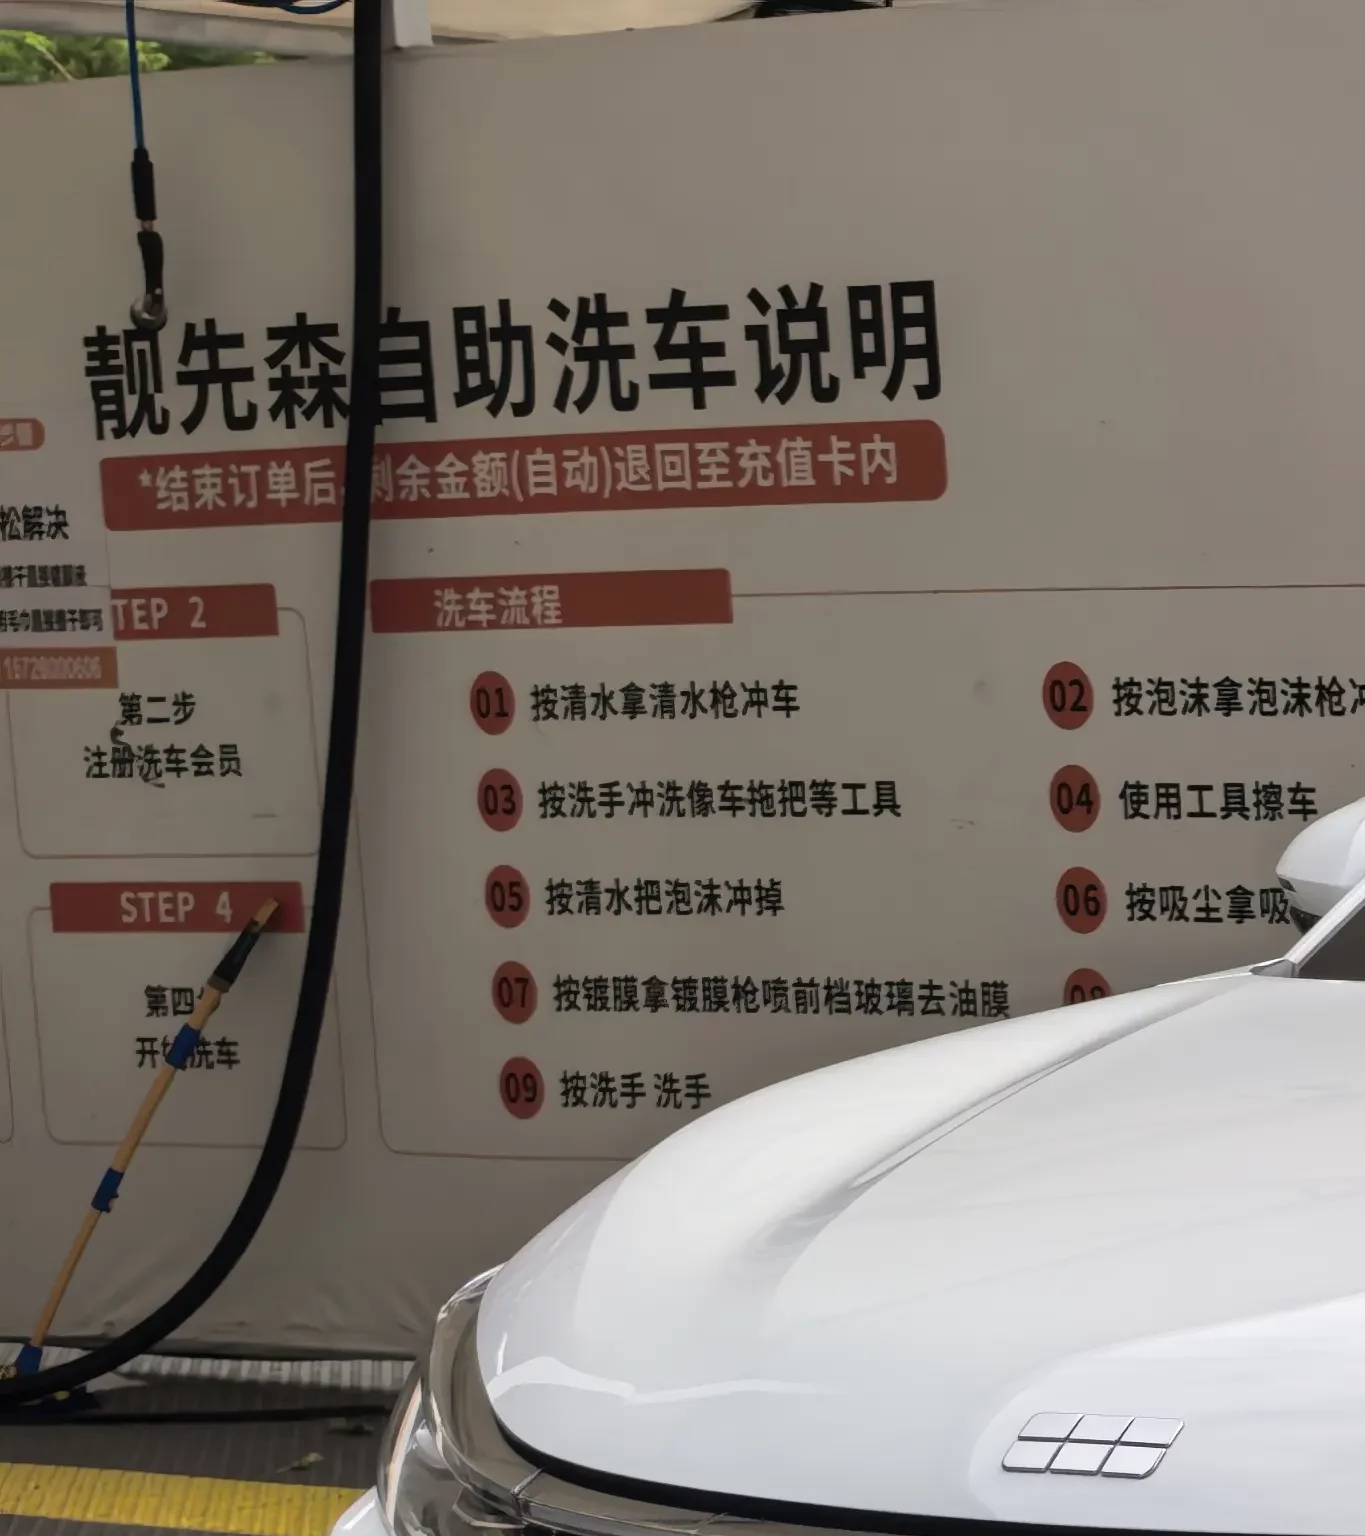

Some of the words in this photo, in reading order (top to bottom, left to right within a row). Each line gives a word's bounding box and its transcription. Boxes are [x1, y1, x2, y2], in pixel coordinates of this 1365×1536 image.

[83, 280, 942, 441] 靓先森自助洗车说明
[111, 596, 169, 631] TEP
[188, 595, 207, 628] 2
[434, 585, 562, 627] 洗车流程
[118, 691, 196, 726] 第二步
[476, 687, 509, 719] 01
[530, 679, 801, 722] 按清水拿清水枪冲车
[1049, 678, 1088, 713] 02
[83, 743, 243, 780] 注册洗车会员
[483, 784, 516, 816] 03
[537, 778, 902, 819] 按洗手冲洗像车拖把等工具
[1056, 782, 1094, 815] 04
[1118, 780, 1318, 822] 使用工具擦车
[120, 891, 195, 923] STEP
[215, 891, 233, 924] 4
[490, 880, 523, 913] 05
[544, 877, 785, 917] 按清水把泡沫冲掉
[1063, 883, 1101, 917] 06
[1124, 880, 1290, 925] 按吸尘拿吸
[497, 976, 530, 1008] 07
[504, 1072, 537, 1104] 09
[560, 1070, 647, 1109] 按洗手
[653, 1072, 712, 1110] 洗手
